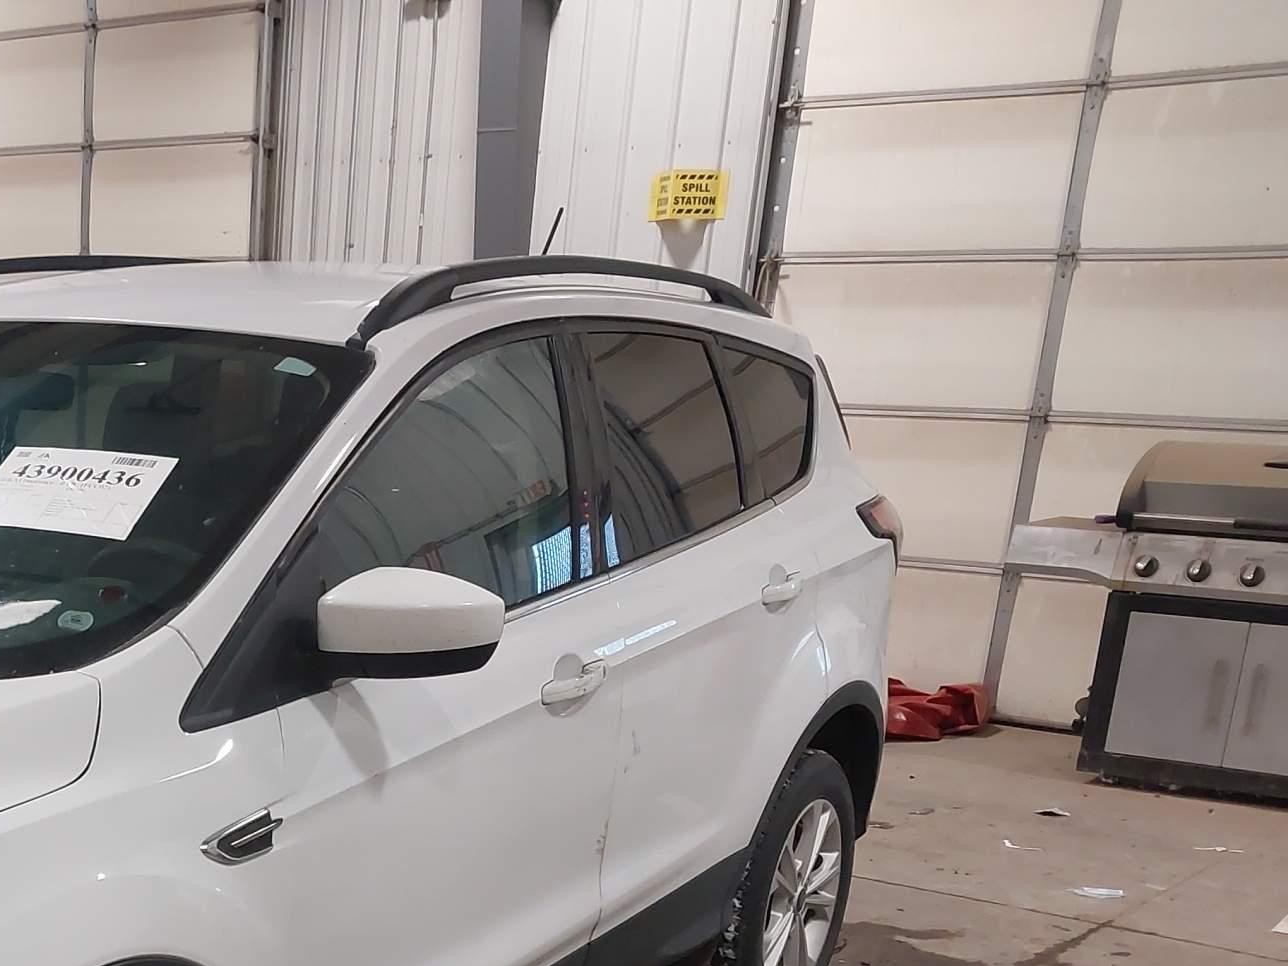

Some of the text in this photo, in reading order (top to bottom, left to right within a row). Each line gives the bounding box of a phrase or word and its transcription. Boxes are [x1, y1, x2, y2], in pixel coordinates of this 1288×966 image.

[681, 183, 710, 193] SPILL
[673, 196, 716, 206] STATION
[12, 463, 145, 488] 43900436
